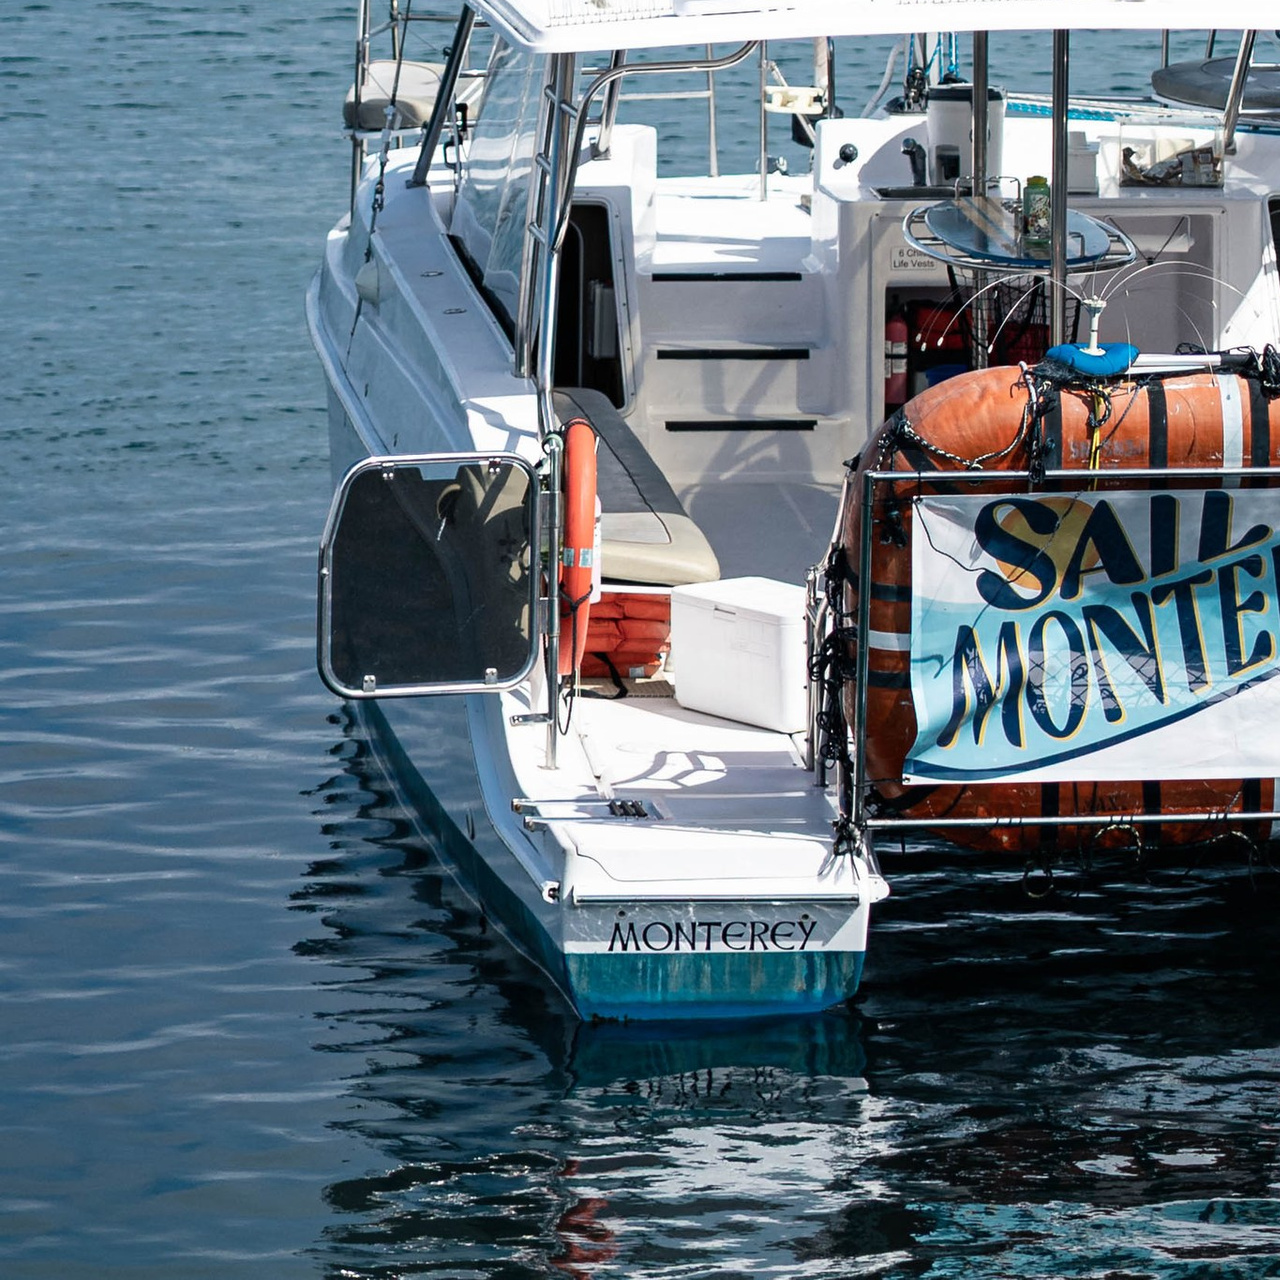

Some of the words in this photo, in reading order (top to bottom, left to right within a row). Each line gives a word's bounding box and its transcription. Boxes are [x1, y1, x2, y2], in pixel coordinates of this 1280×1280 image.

[893, 259, 909, 268] Life
[910, 259, 935, 268] Vests
[974, 490, 1274, 611] SAIL
[607, 920, 818, 952] MONTEREY
